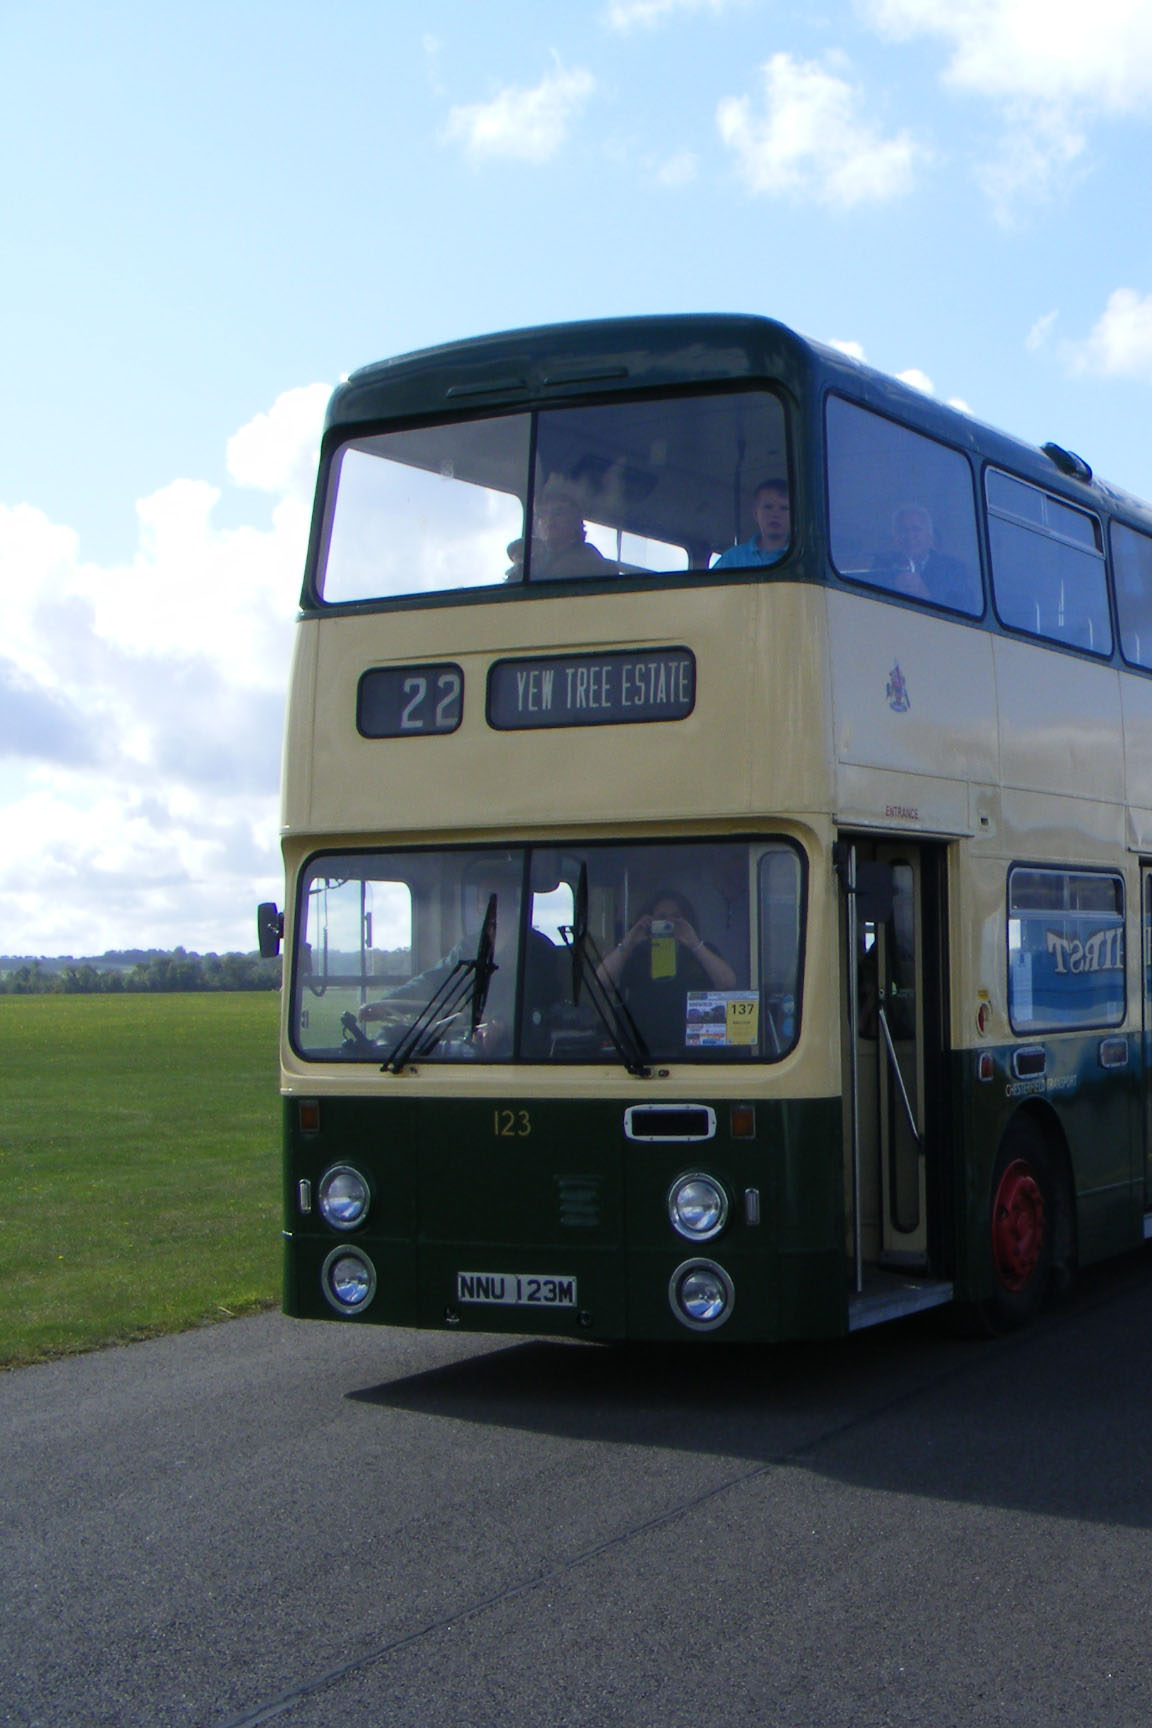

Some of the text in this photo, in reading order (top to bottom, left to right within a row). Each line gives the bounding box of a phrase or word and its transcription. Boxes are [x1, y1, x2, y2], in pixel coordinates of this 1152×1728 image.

[516, 661, 690, 712] YEW TREE ESTATE
[400, 674, 460, 729] 22
[731, 1003, 755, 1016] 137
[493, 1110, 532, 1136] 123
[460, 1275, 574, 1304] NNU 123M
